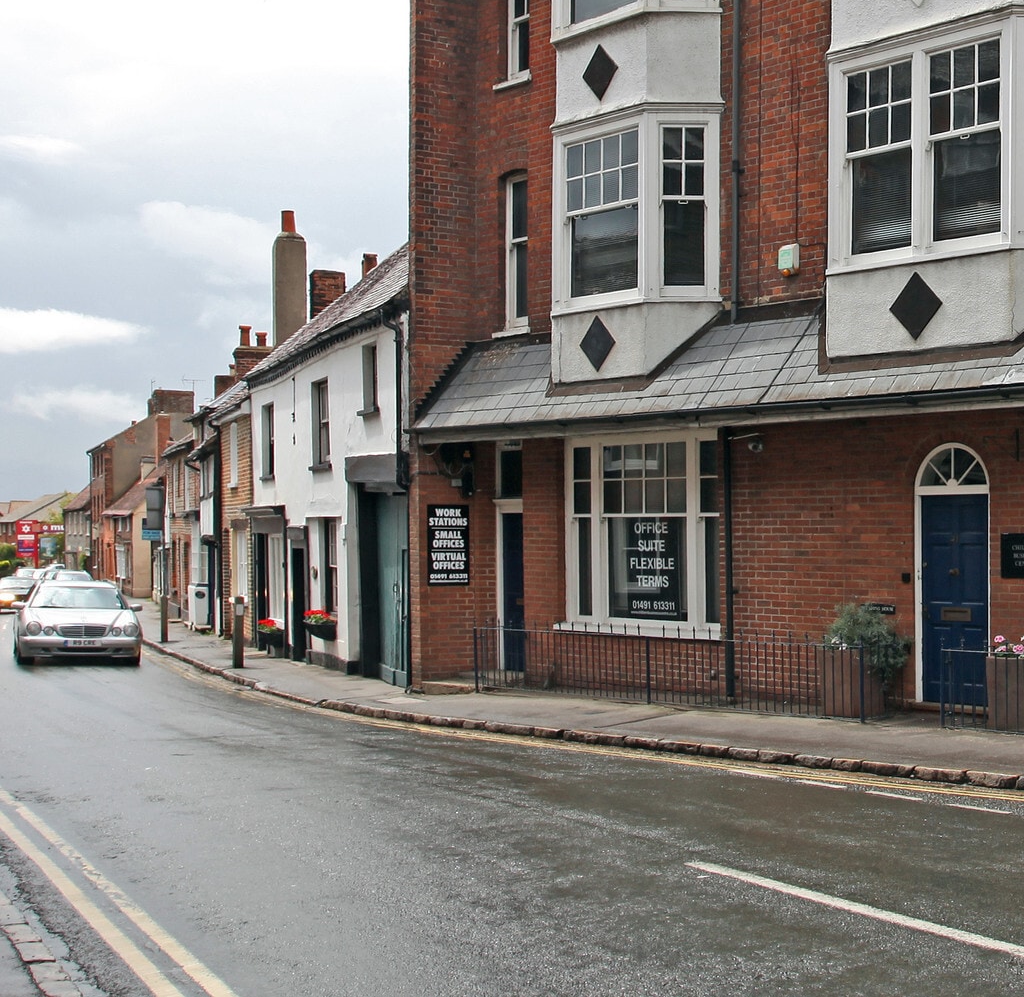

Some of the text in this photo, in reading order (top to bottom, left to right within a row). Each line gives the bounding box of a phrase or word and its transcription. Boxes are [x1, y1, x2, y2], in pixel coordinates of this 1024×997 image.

[435, 508, 461, 517] WORK
[429, 517, 468, 526] STATIONS
[634, 522, 668, 534] OFFICE
[434, 530, 462, 539] SMALL
[432, 539, 465, 548] OFFICES
[638, 539, 666, 552] SUITE
[431, 552, 466, 561] VIRTUAL
[432, 561, 465, 570] OFFICES
[630, 557, 675, 570] FLEXIBLE
[636, 575, 669, 588] TERMS
[632, 600, 675, 611] 01491 613311
